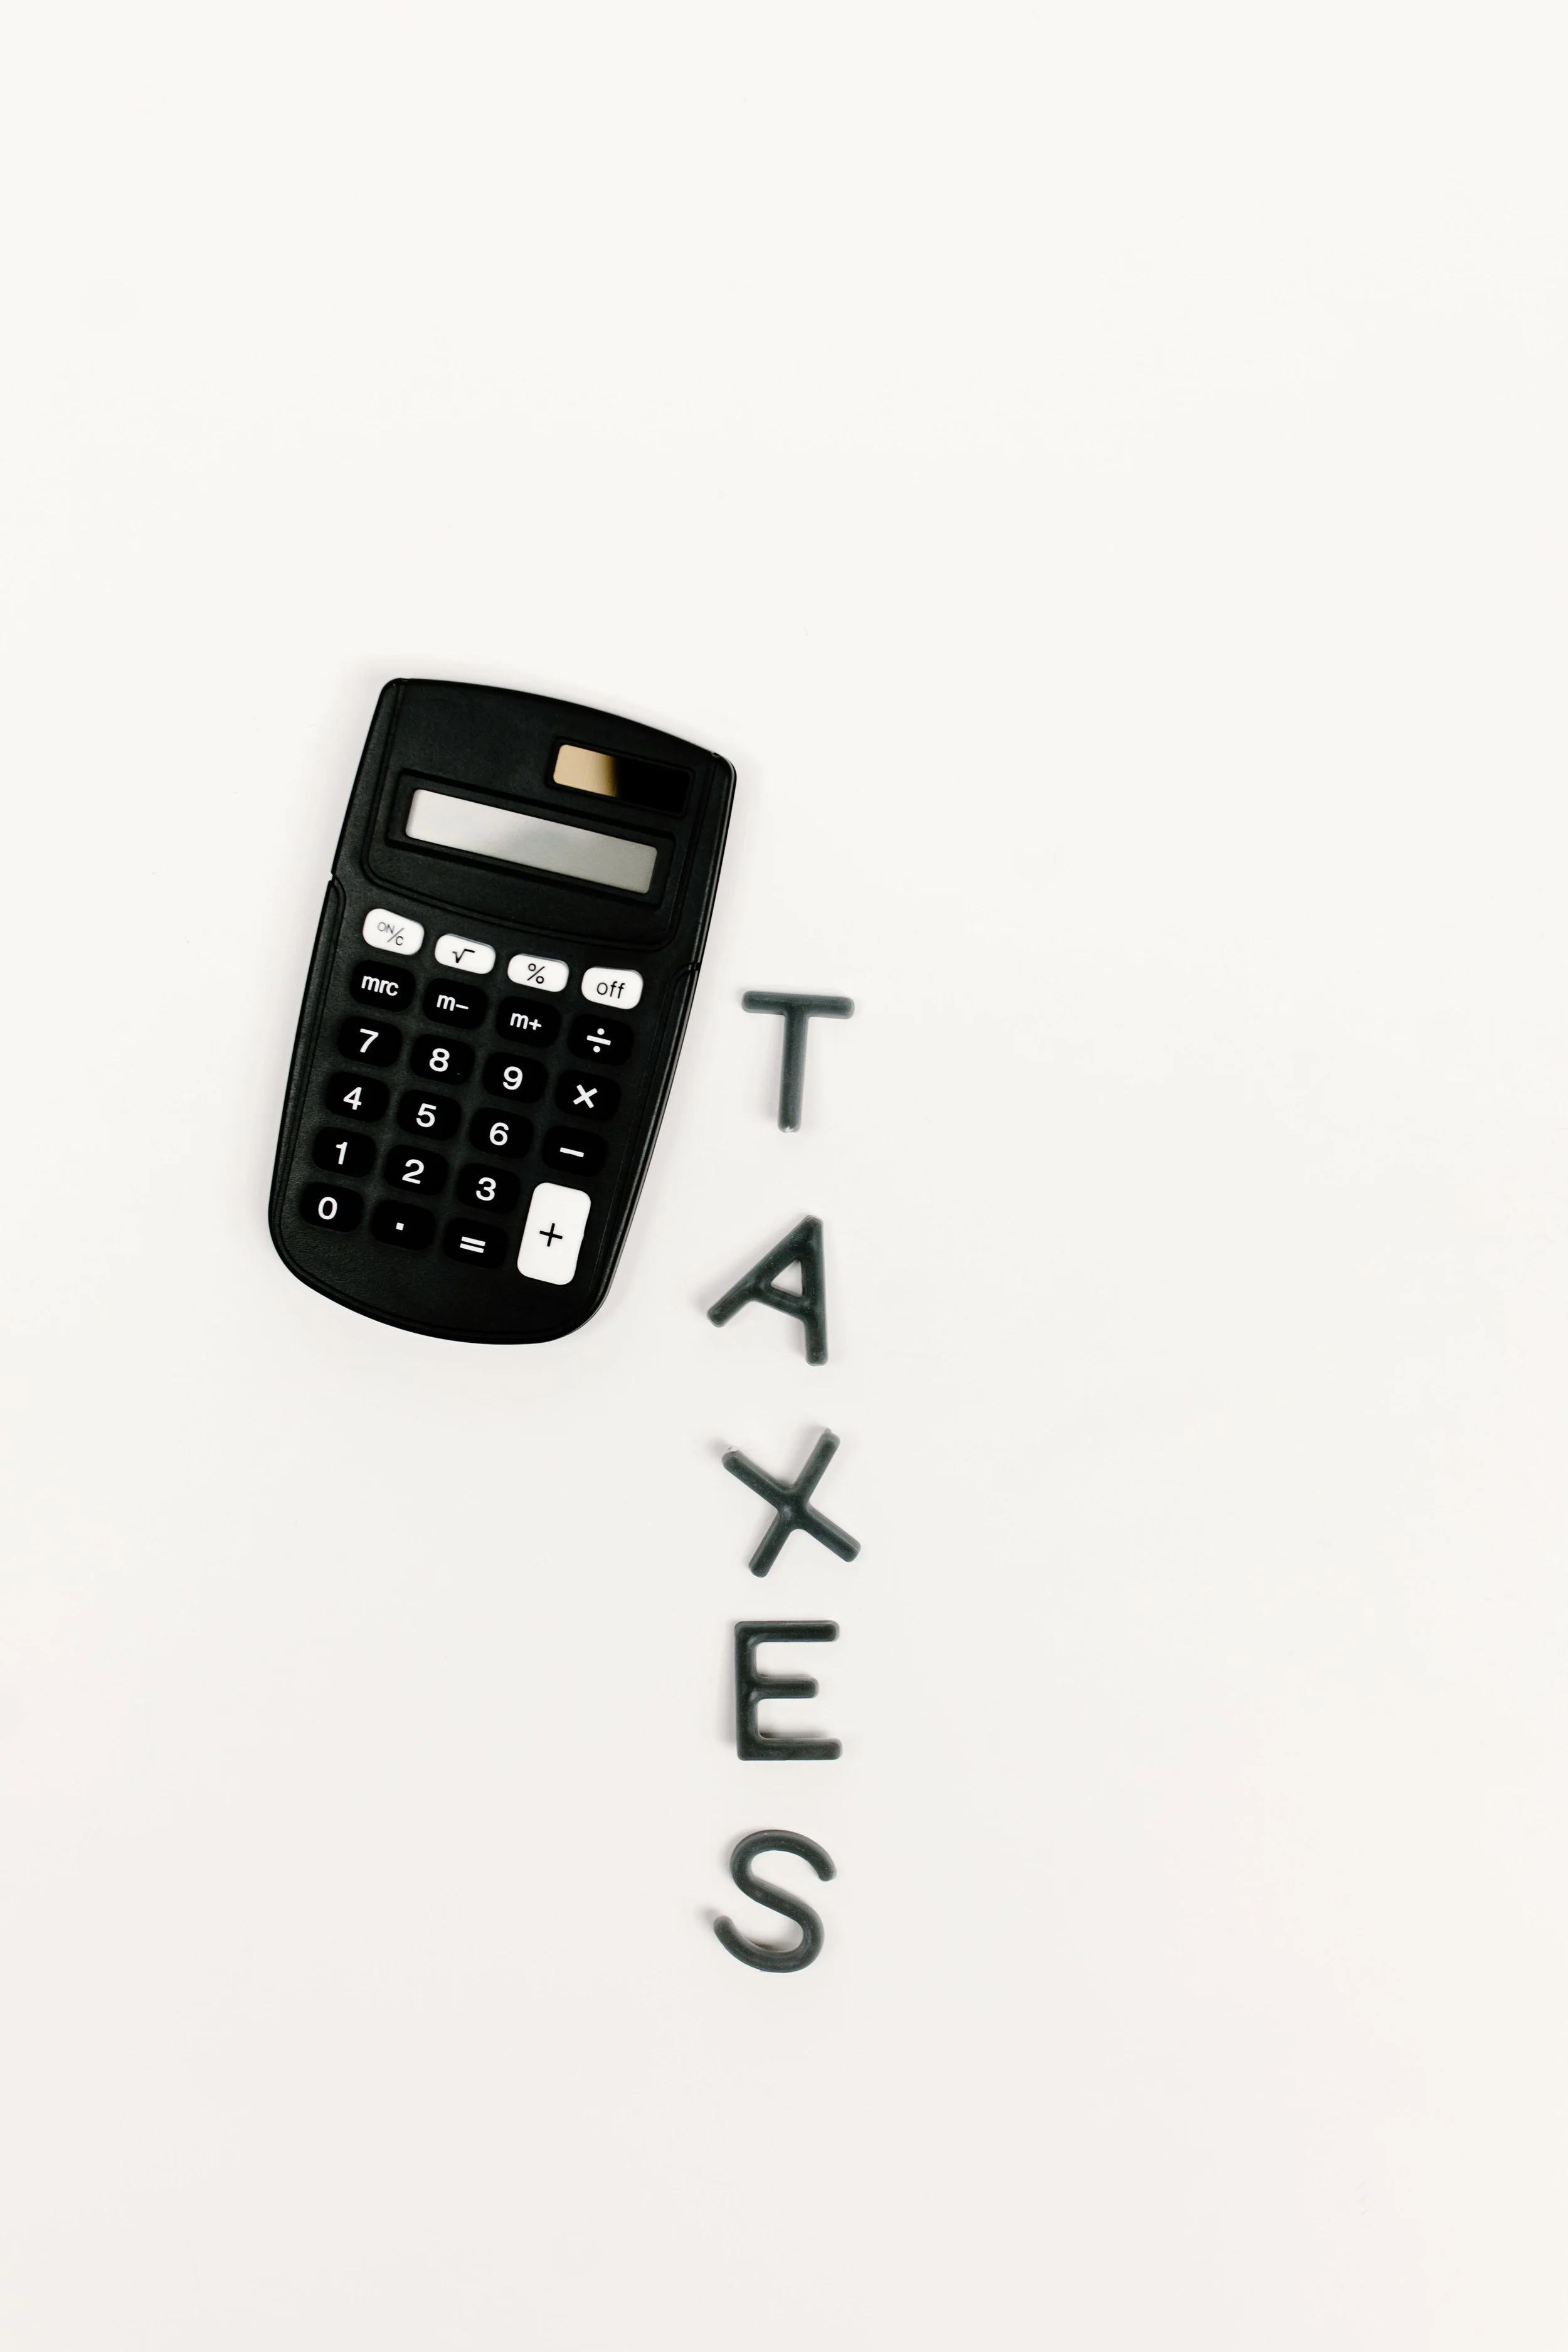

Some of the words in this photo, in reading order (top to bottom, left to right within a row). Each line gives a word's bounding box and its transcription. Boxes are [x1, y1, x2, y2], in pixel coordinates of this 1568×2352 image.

[361, 975, 400, 996] mrc
[526, 963, 546, 984] %
[596, 980, 625, 999] off
[509, 1012, 542, 1030] m+
[359, 1028, 379, 1053] 7
[429, 1047, 450, 1072] 8
[502, 1066, 523, 1090] 9
[343, 1086, 362, 1110] 4
[416, 1103, 437, 1128] 5
[489, 1122, 509, 1146] 6
[336, 1142, 347, 1165] 1
[402, 1158, 425, 1184] 2
[475, 1177, 497, 1201] 3
[318, 1197, 337, 1220] 0
[706, 990, 861, 1974] TAXES
